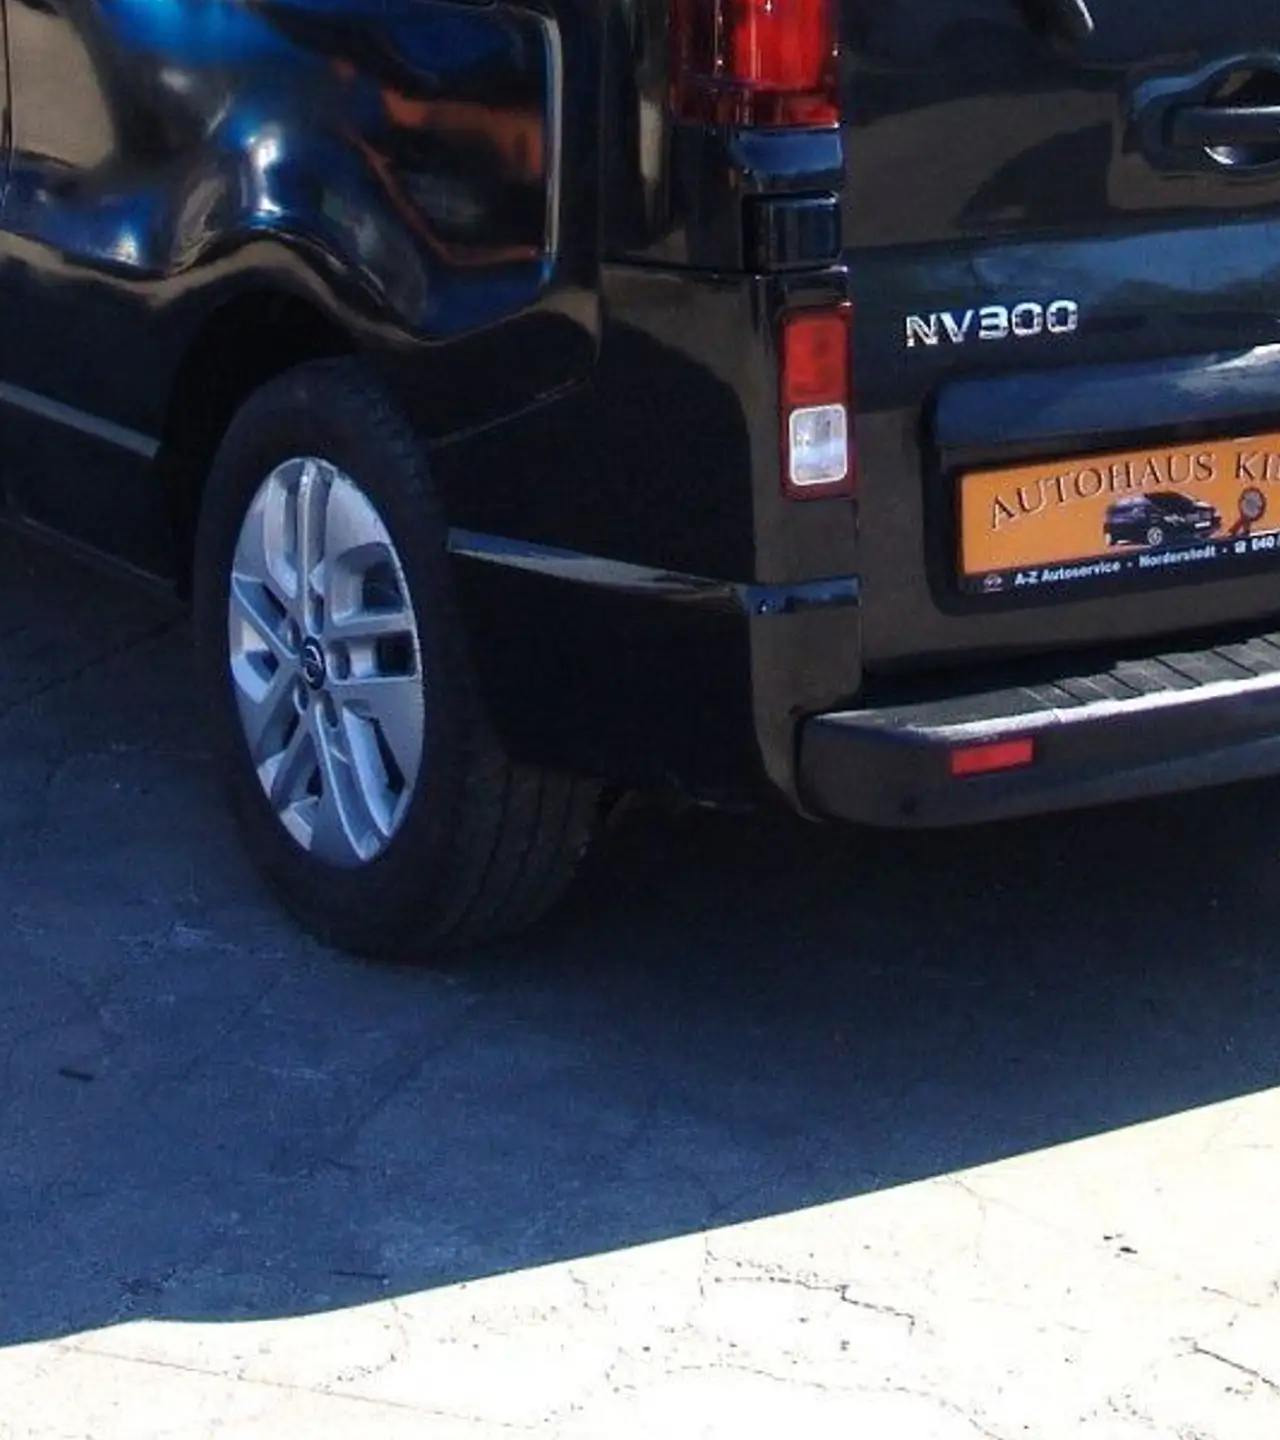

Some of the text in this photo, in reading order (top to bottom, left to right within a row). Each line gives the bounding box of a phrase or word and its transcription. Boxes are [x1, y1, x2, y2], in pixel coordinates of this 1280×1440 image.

[905, 298, 1080, 348] NV300
[988, 452, 1217, 530] AUTOHAUS
[1014, 569, 1040, 586] A-Z
[1041, 561, 1121, 581] Autoservice
